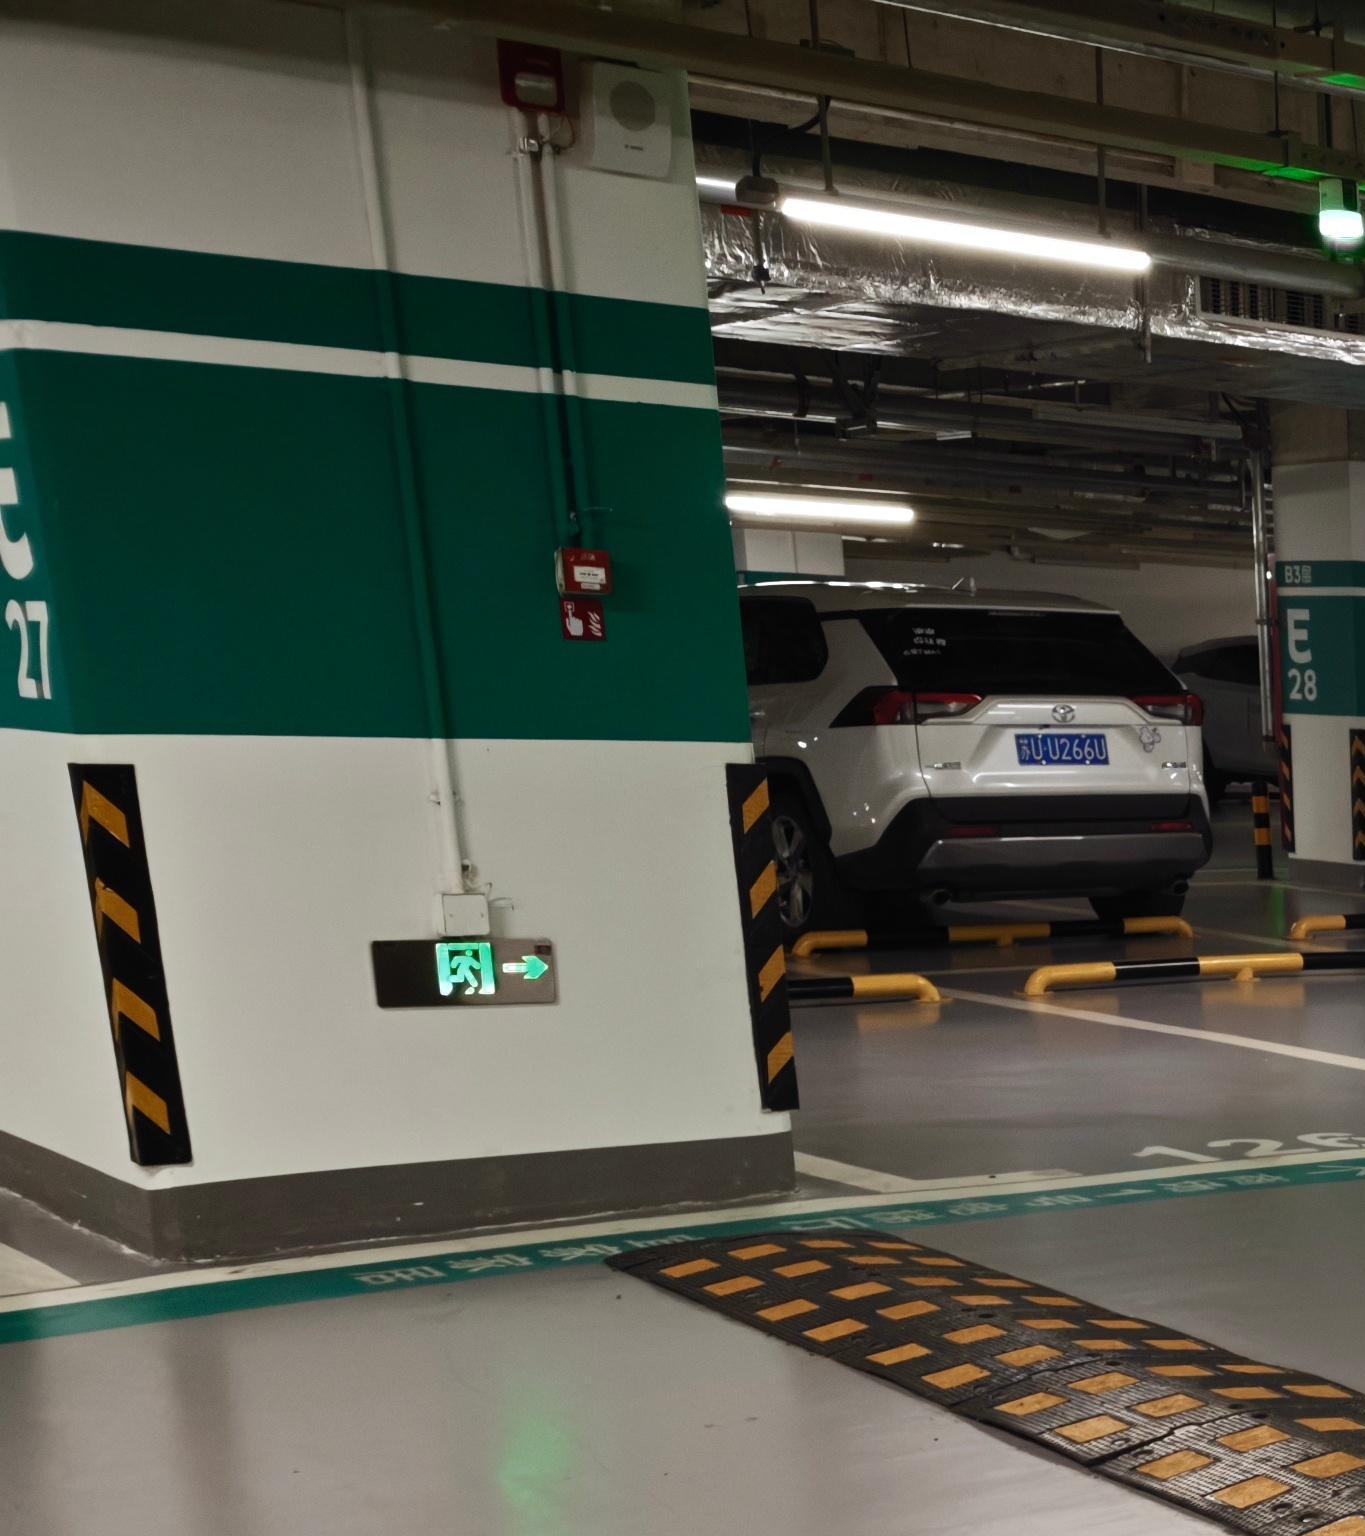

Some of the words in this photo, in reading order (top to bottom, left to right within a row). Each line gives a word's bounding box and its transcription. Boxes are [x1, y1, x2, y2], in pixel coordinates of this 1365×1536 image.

[5, 599, 52, 700] 27
[1286, 608, 1313, 665] E
[1287, 668, 1318, 702] 28
